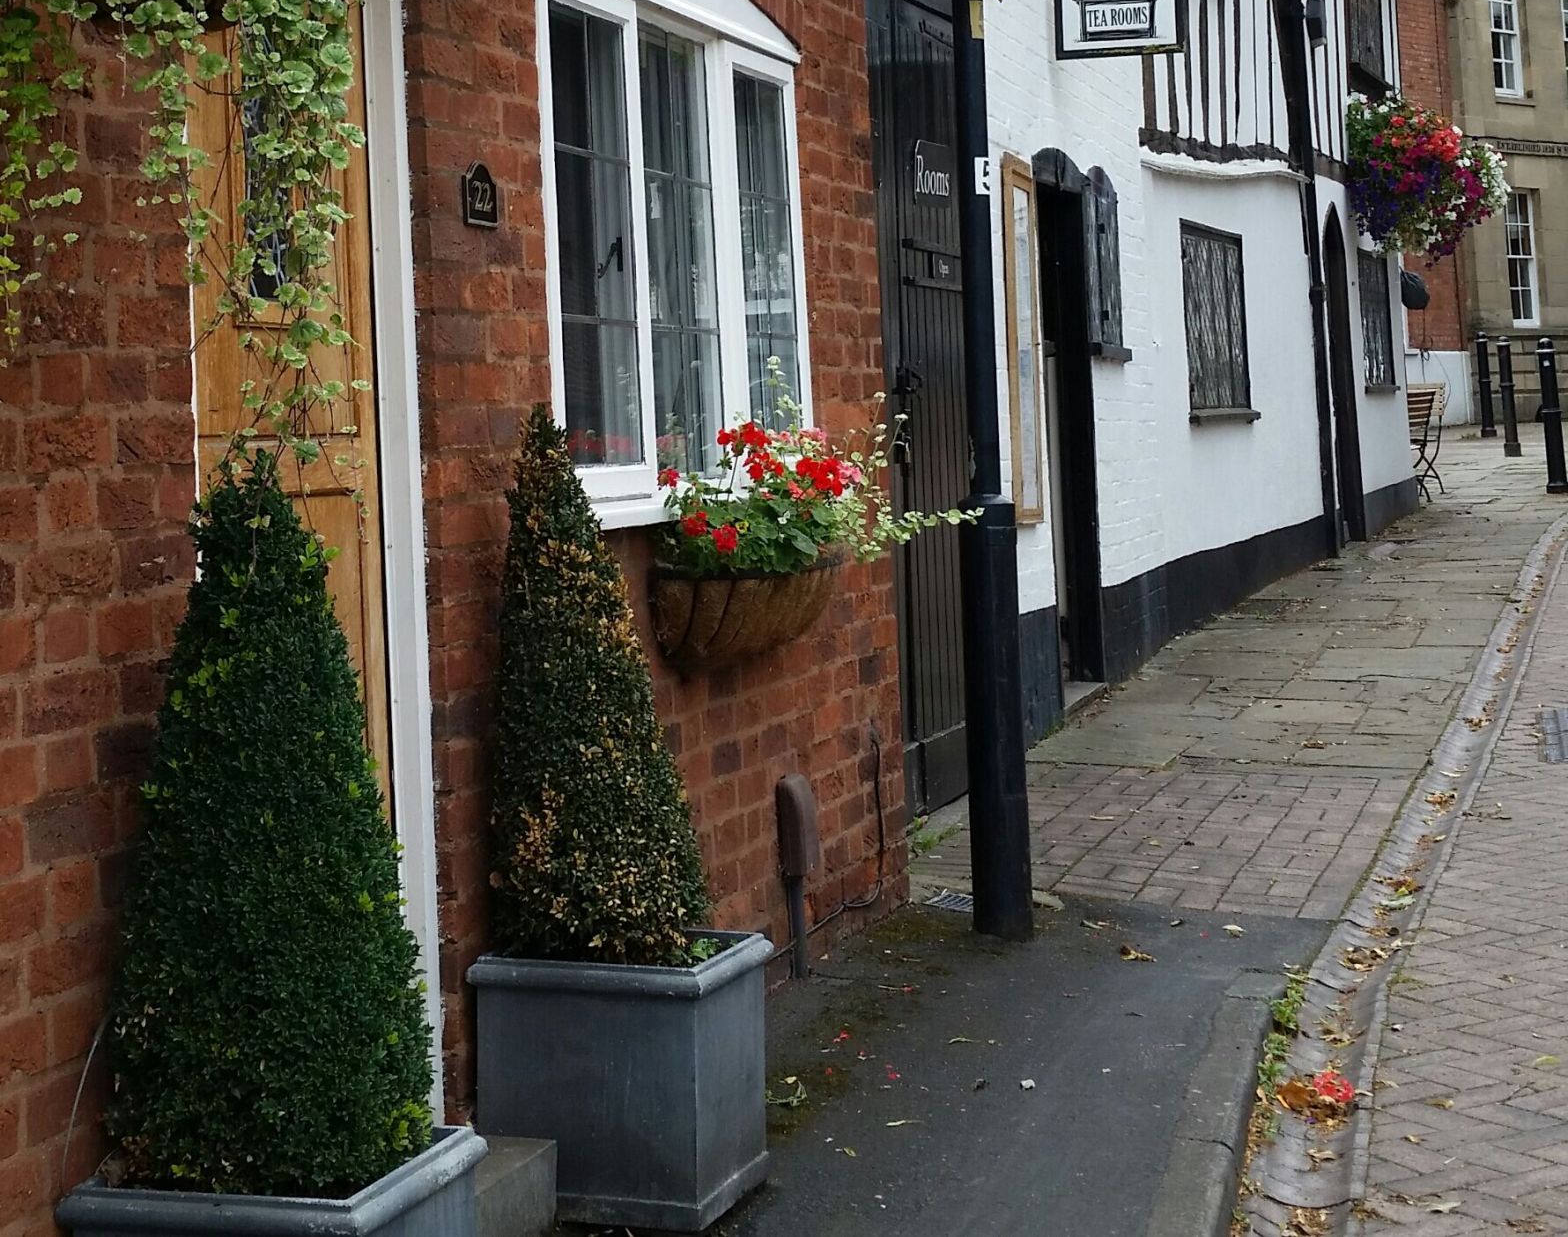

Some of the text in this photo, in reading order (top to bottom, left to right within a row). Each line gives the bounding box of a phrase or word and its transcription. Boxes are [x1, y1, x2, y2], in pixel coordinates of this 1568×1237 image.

[1087, 6, 1148, 28] TEA ROOMS
[916, 155, 950, 197] Rooms
[471, 180, 494, 212] 22
